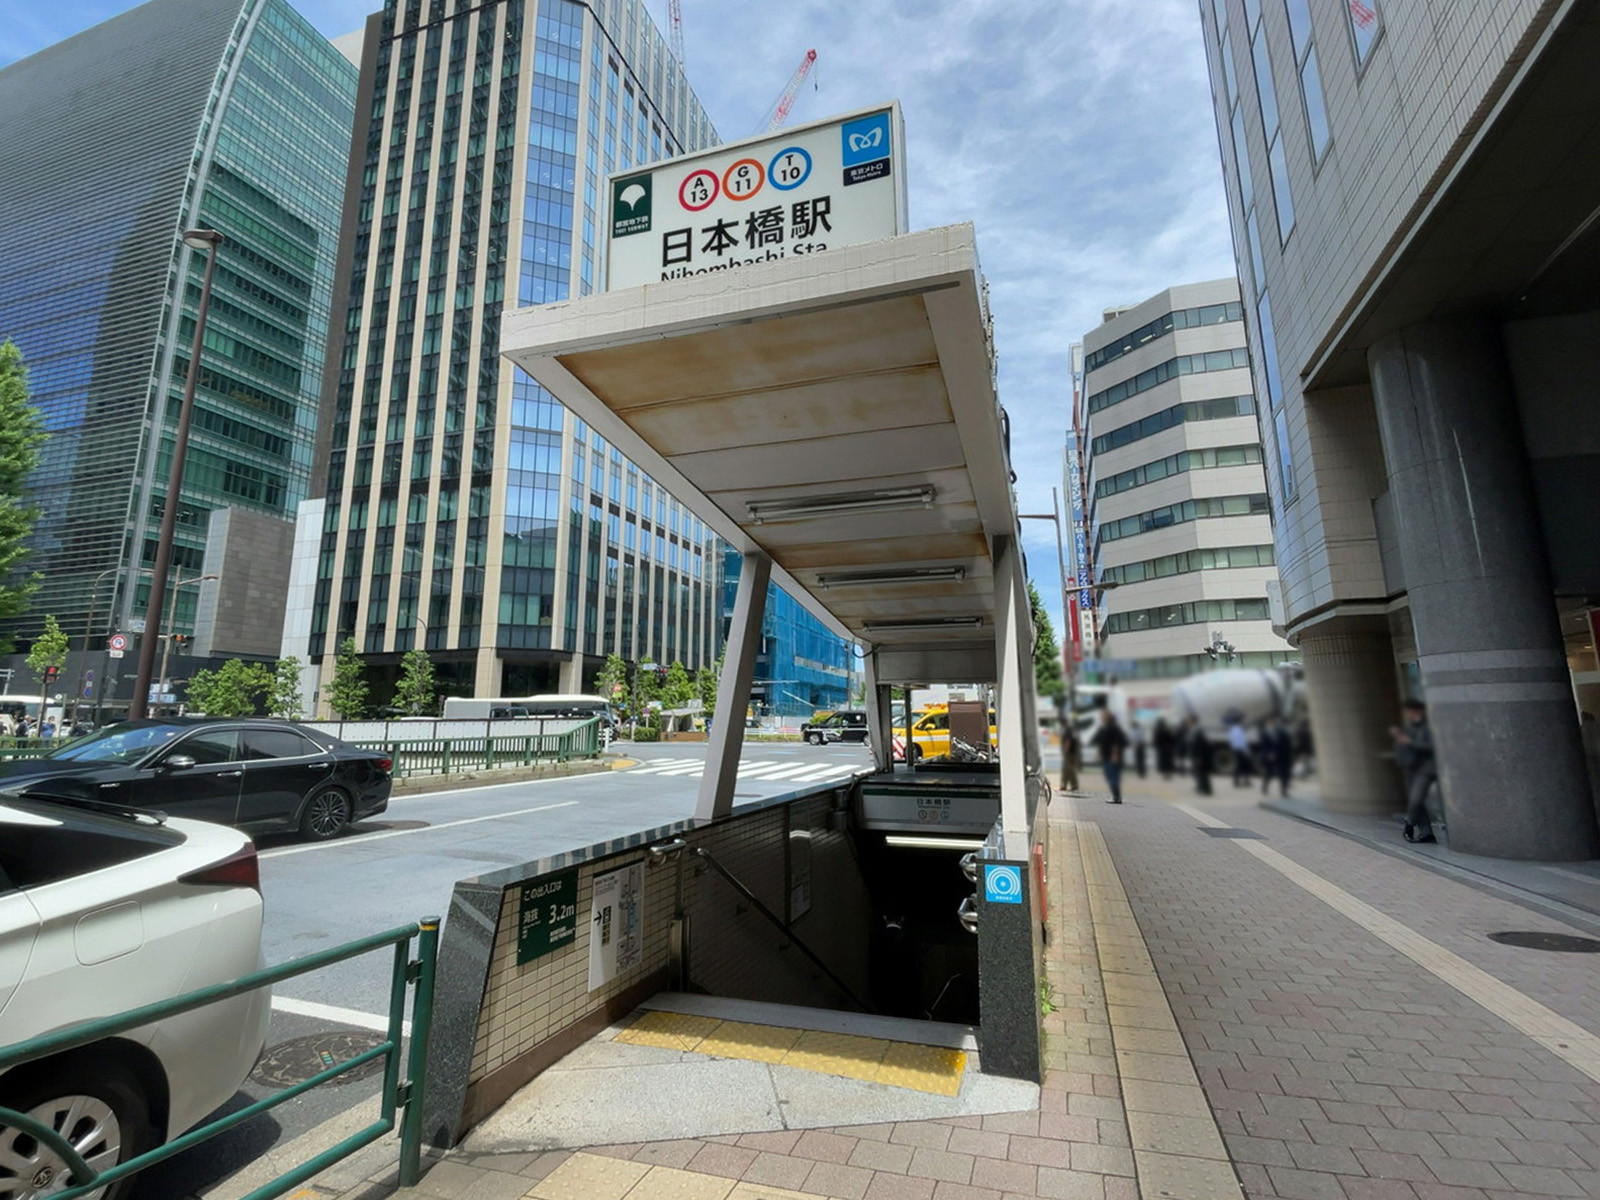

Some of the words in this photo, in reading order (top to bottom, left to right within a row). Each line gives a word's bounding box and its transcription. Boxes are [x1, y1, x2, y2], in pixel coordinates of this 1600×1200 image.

[785, 154, 794, 166] T
[737, 166, 750, 178] G
[781, 166, 800, 181] 10
[693, 177, 705, 189] A
[735, 178, 751, 192] 11
[690, 188, 709, 203] 13
[662, 195, 833, 268] 日本橋駅
[548, 904, 575, 925] 3.2m
